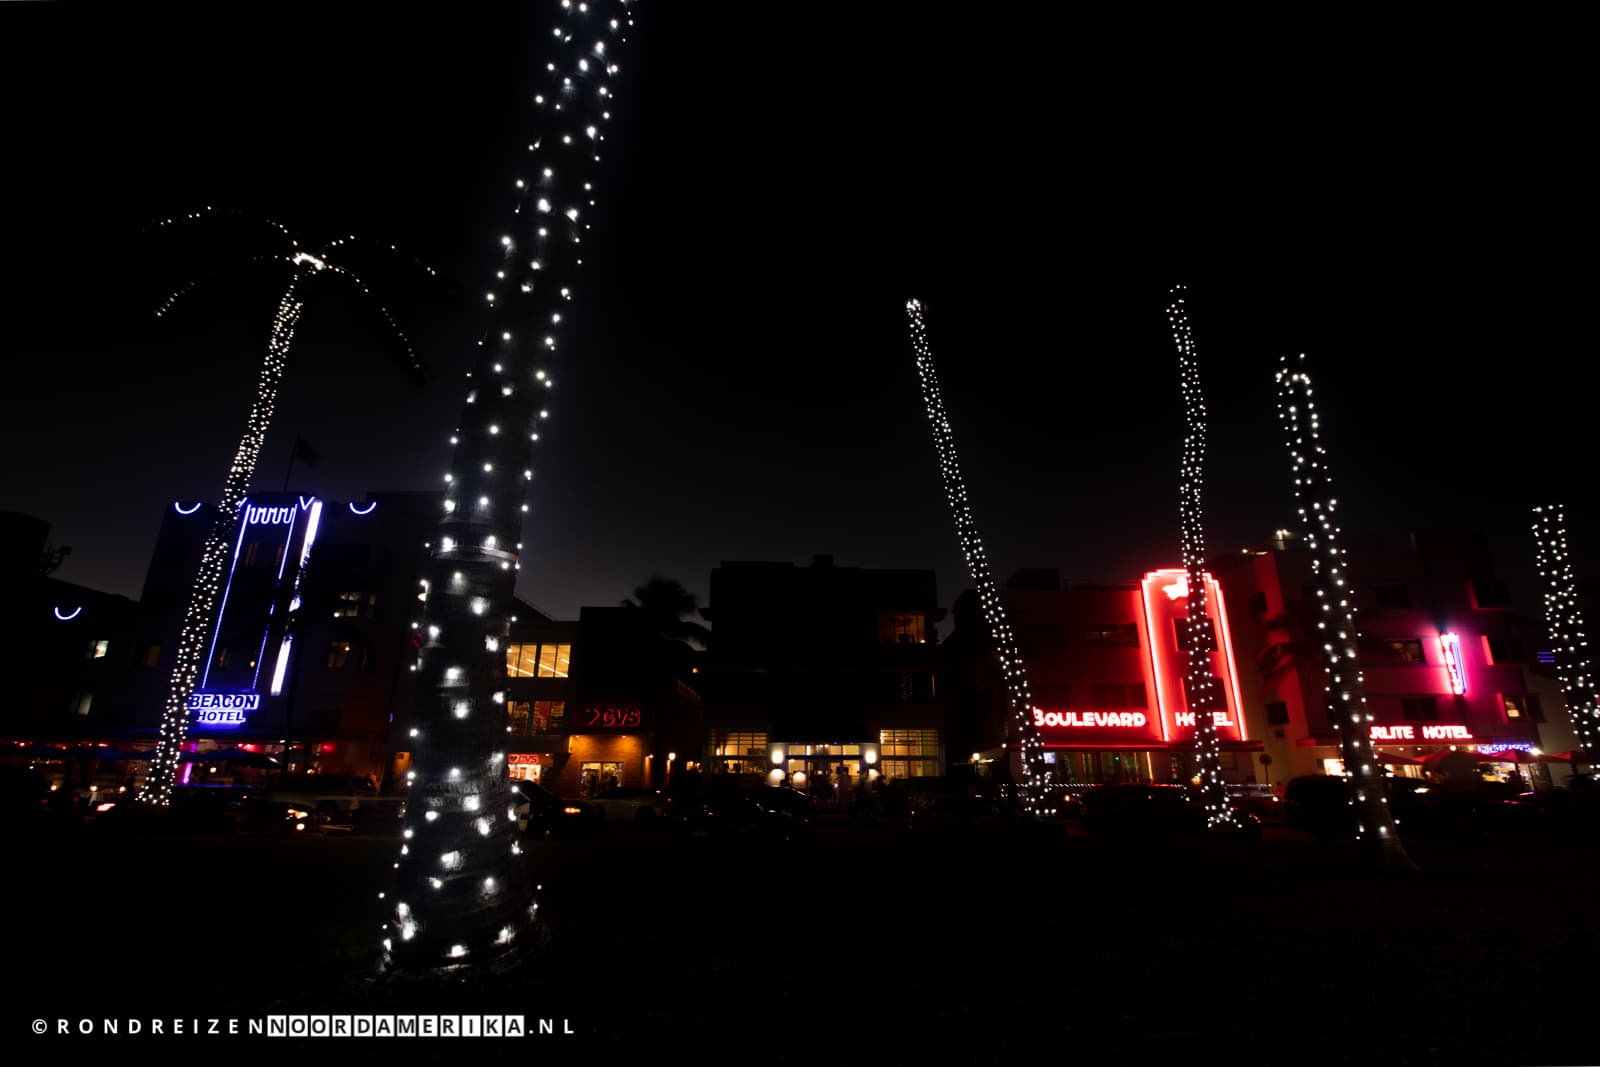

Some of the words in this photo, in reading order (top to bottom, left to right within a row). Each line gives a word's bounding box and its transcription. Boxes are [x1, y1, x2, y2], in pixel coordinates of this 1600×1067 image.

[189, 694, 260, 710] BEACON
[197, 710, 246, 723] HOTEL
[601, 707, 641, 727] CVS
[1033, 707, 1146, 727] BOULEVARD
[1175, 711, 1234, 727] HOEL
[1369, 726, 1415, 739] RLITE
[1422, 725, 1473, 739] HOTEL
